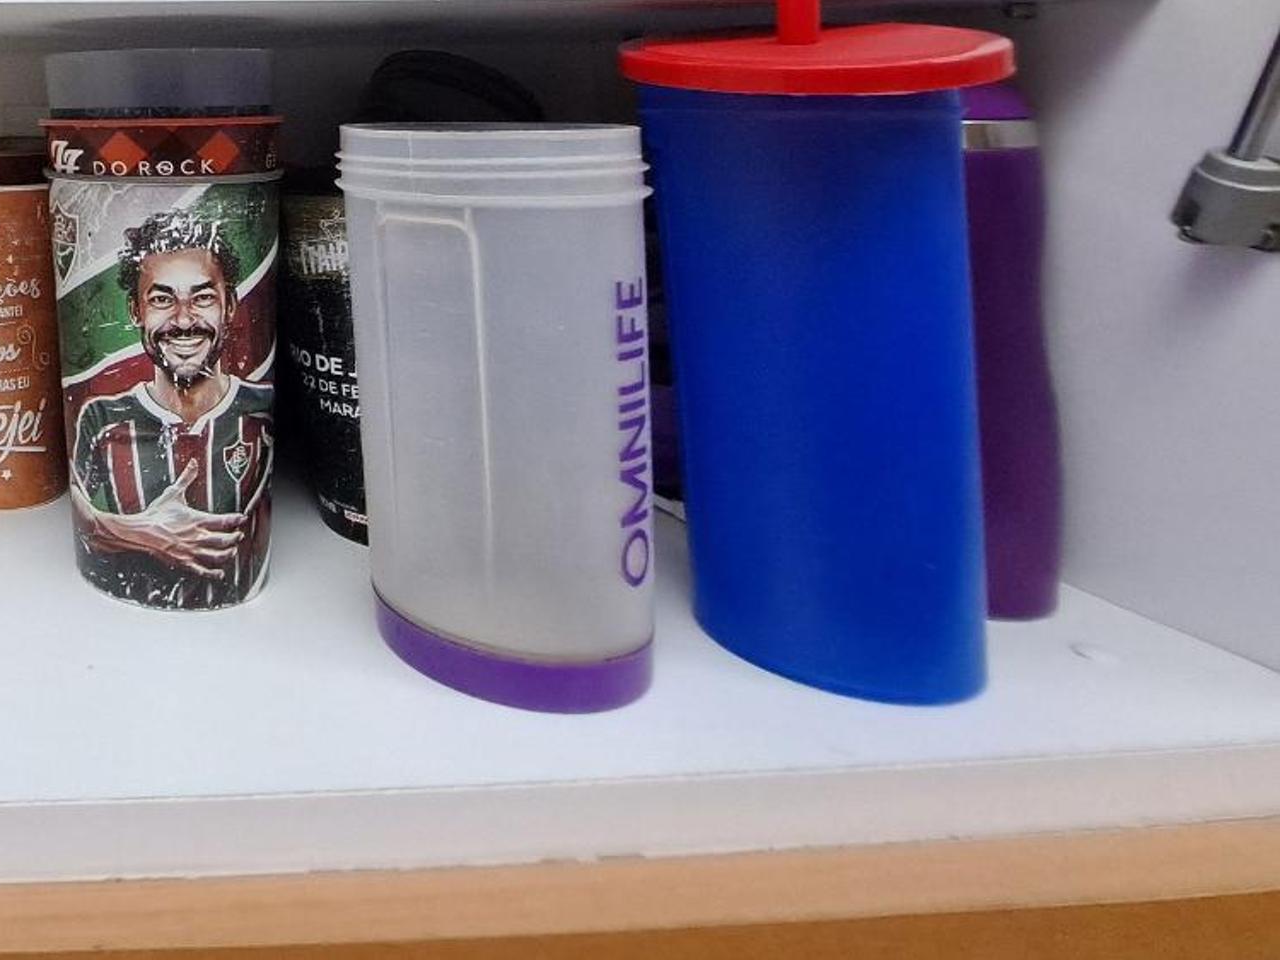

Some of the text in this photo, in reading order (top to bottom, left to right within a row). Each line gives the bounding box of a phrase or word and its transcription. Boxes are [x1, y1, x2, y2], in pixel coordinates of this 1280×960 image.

[92, 159, 216, 176] DO ROCK
[315, 354, 344, 376] DE
[18, 376, 30, 389] EU
[319, 379, 339, 395] DE
[616, 276, 650, 587] OMNILIFE
